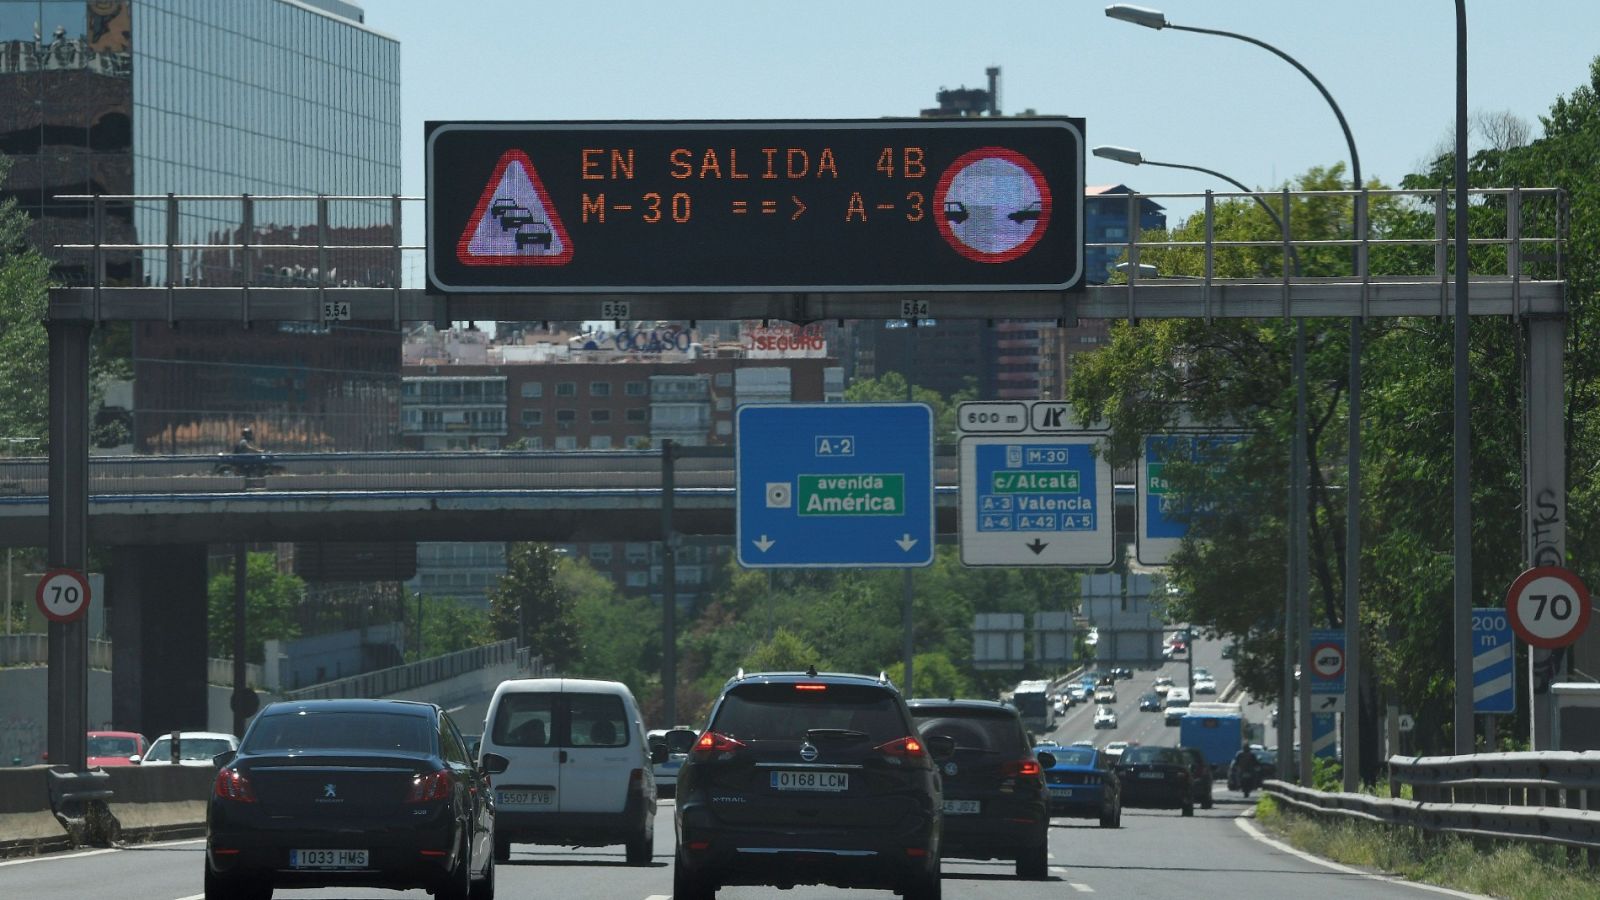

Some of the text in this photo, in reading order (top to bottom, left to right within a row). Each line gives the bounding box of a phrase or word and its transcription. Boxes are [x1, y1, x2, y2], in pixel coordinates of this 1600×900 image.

[581, 147, 927, 180] EN SALIDA 4B
[581, 191, 692, 224] M-30
[845, 191, 926, 223] A-3
[967, 412, 1018, 424] 600 m
[818, 439, 852, 454] A-2
[1028, 451, 1067, 463] M-30
[817, 476, 884, 490] avenida
[994, 473, 1079, 489] c/Alcalá
[806, 493, 896, 512] América
[983, 496, 1092, 510] A-3 Valencia
[983, 516, 1092, 528] A-4 A-42 A-5
[51, 586, 79, 604] 70
[1528, 593, 1573, 622] 70
[1471, 616, 1507, 631] 200
[1481, 635, 1497, 646] m
[780, 772, 847, 788] 0168 LCM
[503, 793, 529, 803] 5507
[301, 851, 366, 865] 1033 HMS
